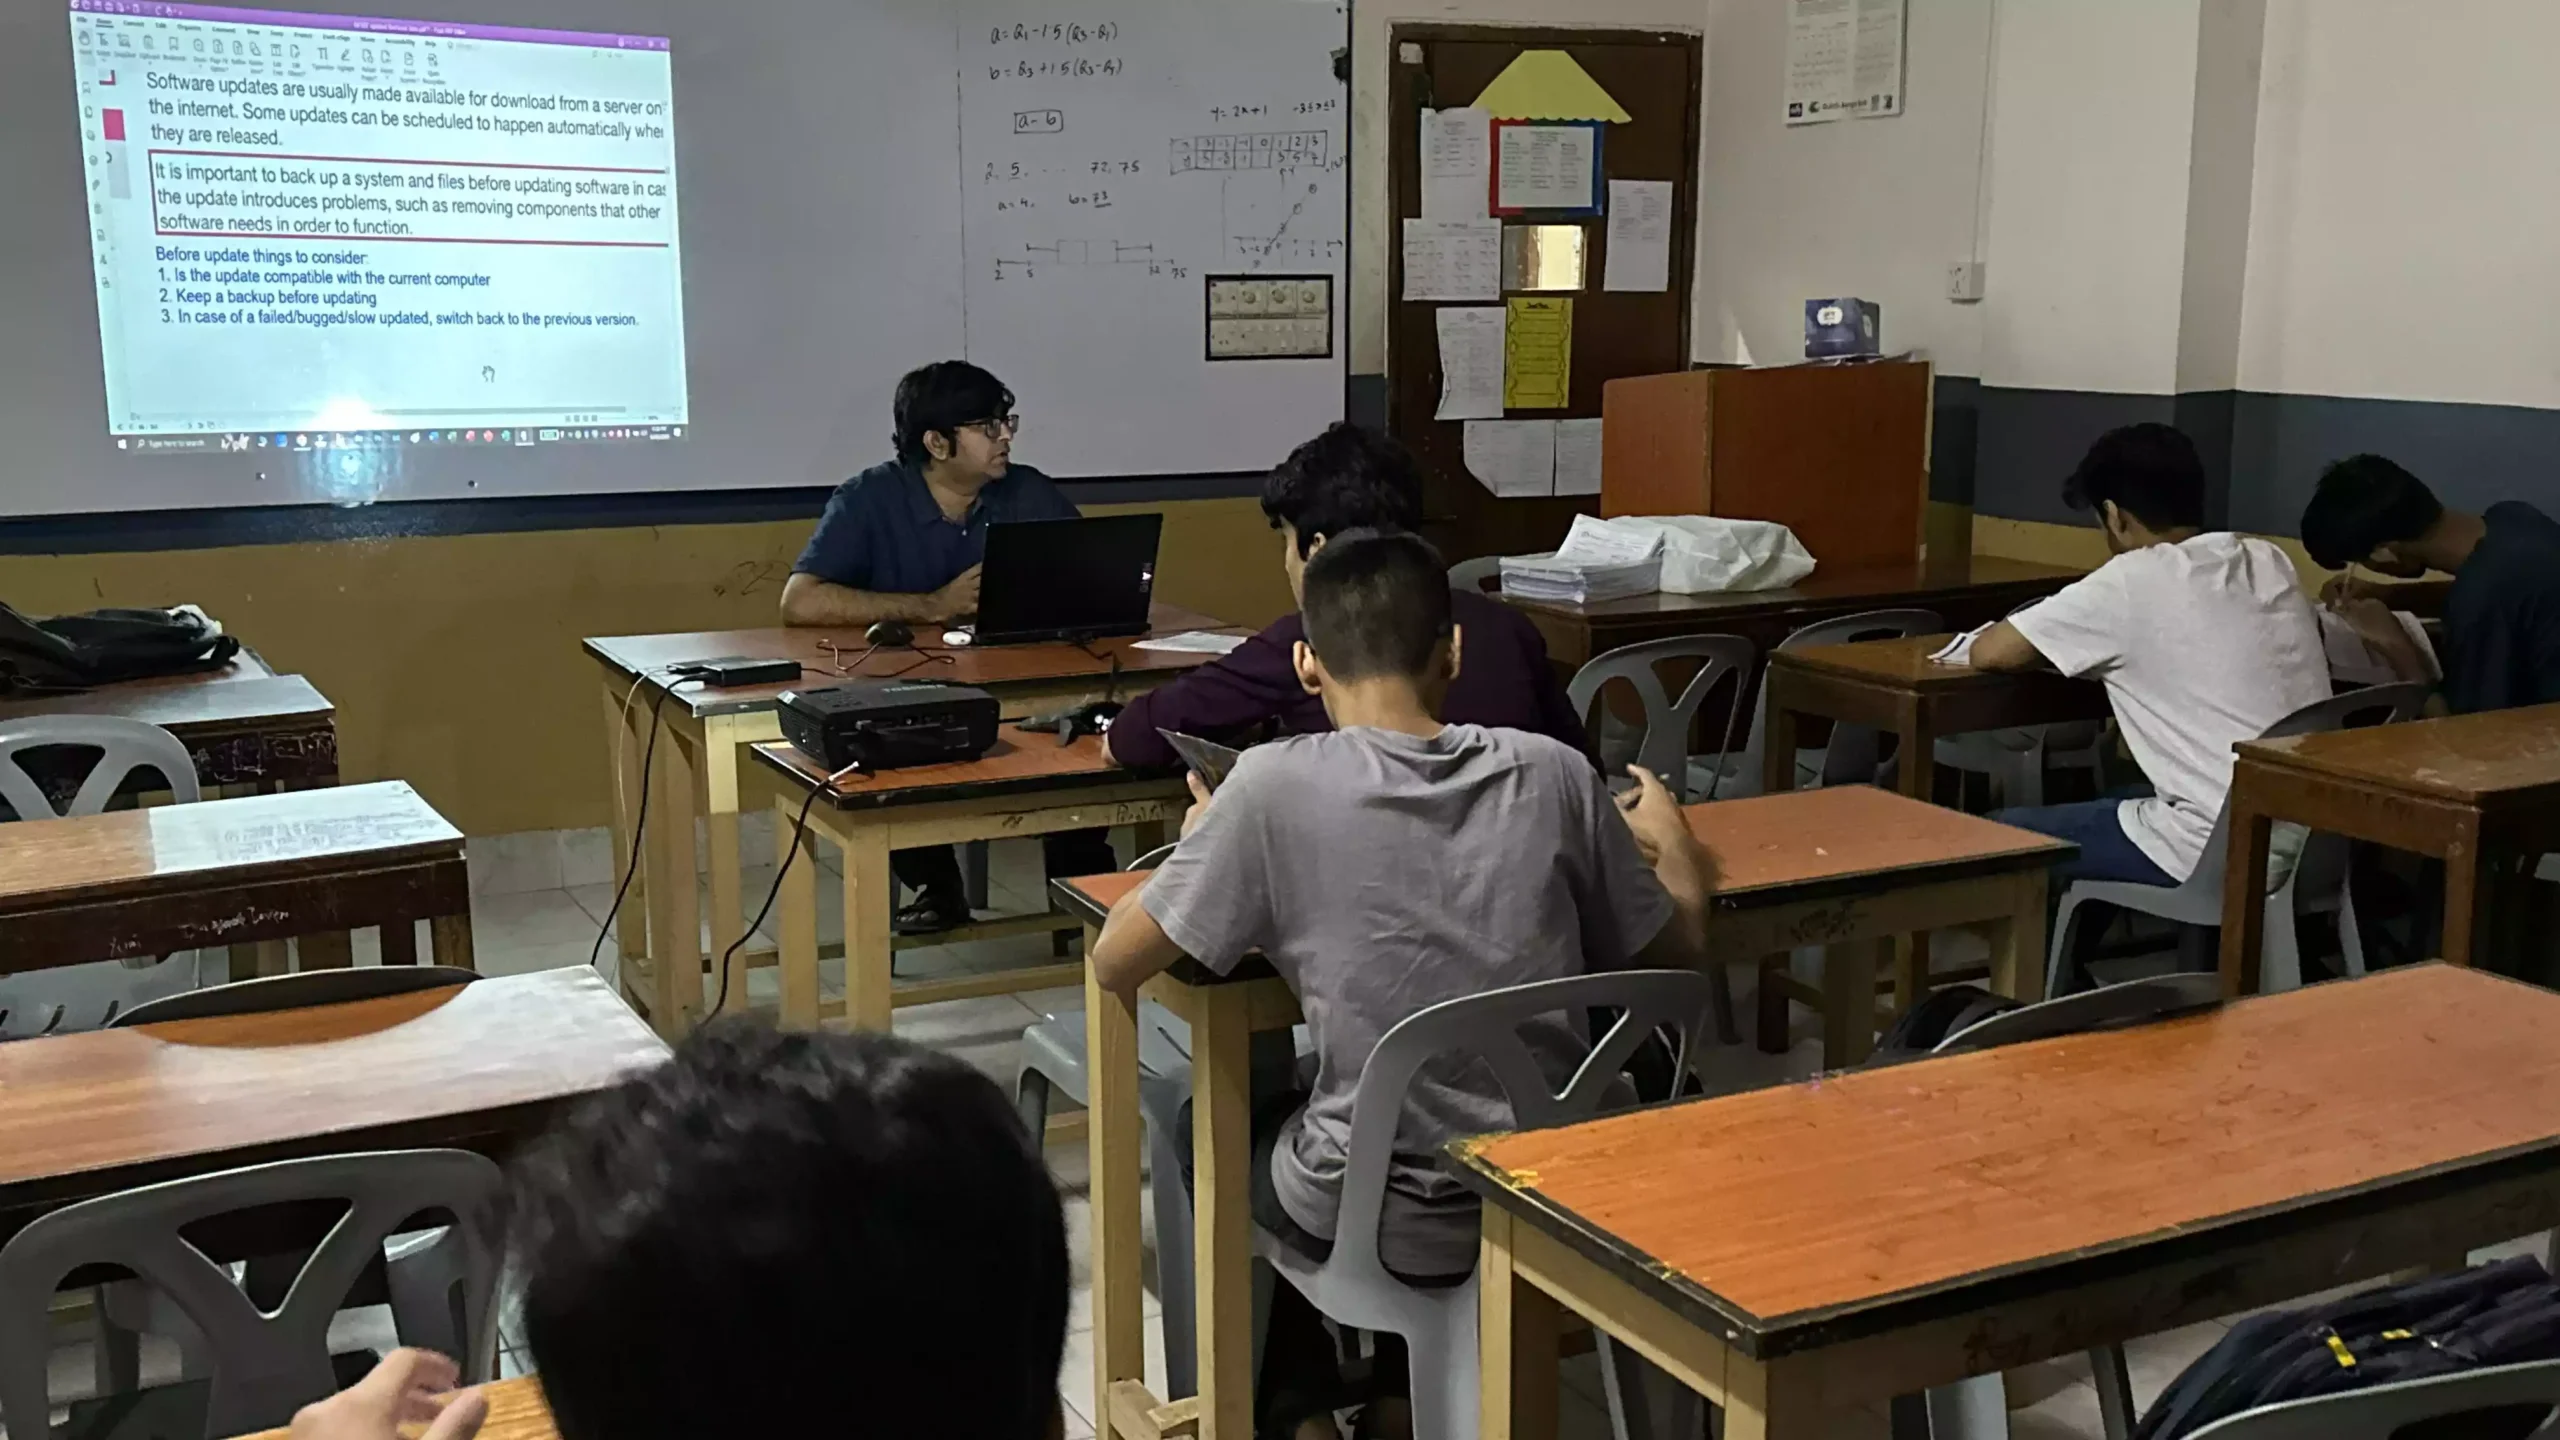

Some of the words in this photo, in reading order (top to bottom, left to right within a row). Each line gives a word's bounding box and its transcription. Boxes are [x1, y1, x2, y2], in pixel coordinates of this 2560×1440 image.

[146, 71, 216, 93] Software
[217, 75, 279, 100] updates
[282, 83, 306, 98] are
[308, 84, 359, 105] usually
[361, 84, 404, 102] made
[405, 83, 467, 107] available
[468, 89, 489, 107] for
[490, 91, 556, 111] download
[558, 94, 589, 113] from
[591, 100, 602, 113] a
[603, 100, 644, 116] server
[645, 103, 663, 115] on
[147, 97, 174, 116] the
[177, 98, 239, 119] internet.
[242, 102, 286, 121] Some
[289, 107, 348, 126] updates
[351, 111, 378, 125] can
[380, 109, 400, 127] be
[402, 110, 474, 130] scheduled
[476, 116, 491, 131] to
[493, 115, 544, 137] happen
[547, 119, 632, 142] automatically
[150, 124, 185, 146] they
[187, 127, 214, 144] are
[215, 124, 284, 146] released.
[155, 163, 166, 180] It
[168, 161, 183, 180] is
[184, 161, 259, 187] important
[260, 166, 277, 184] to
[279, 165, 317, 186] back
[318, 172, 339, 190] up
[341, 172, 352, 187] a
[353, 171, 405, 192] system
[407, 171, 435, 189] and
[436, 172, 466, 190] files
[467, 173, 512, 193] before
[514, 176, 573, 198] updating
[574, 178, 631, 196] software
[632, 180, 645, 197] in
[157, 189, 182, 206] the
[185, 191, 238, 212] update
[240, 190, 319, 210] introduces
[321, 192, 392, 216] problems,
[394, 195, 429, 213] such
[431, 200, 449, 214] as
[451, 196, 514, 220] removing
[516, 201, 598, 221] components
[599, 202, 626, 220] that
[627, 203, 662, 220] other
[160, 214, 223, 231] software
[227, 215, 273, 232] needs
[277, 216, 290, 232] in
[293, 217, 331, 233] order
[335, 218, 350, 233] to
[353, 218, 413, 235] function.
[154, 245, 201, 263] Before
[203, 246, 251, 268] update
[252, 247, 293, 268] things
[294, 249, 309, 264] to
[173, 266, 189, 283] Is
[189, 267, 213, 283] the
[214, 266, 261, 287] update
[263, 268, 334, 288] compatible
[335, 269, 363, 285] with
[364, 269, 386, 285] the
[387, 271, 433, 287] current
[433, 272, 492, 290] computer
[175, 287, 213, 308] Keep
[214, 291, 225, 304] a
[226, 288, 276, 308] backup
[277, 289, 320, 305] before
[321, 289, 378, 308] updating
[177, 308, 192, 324] In
[194, 306, 227, 324] case
[229, 308, 245, 324] of
[246, 311, 256, 324] a
[257, 308, 377, 328] failed/bugged/slow
[378, 309, 434, 329] updated,
[435, 310, 474, 326] switch
[476, 310, 506, 325] back
[507, 311, 520, 325] to
[521, 312, 542, 326] the
[543, 312, 593, 329] previous
[594, 312, 640, 326] version.
